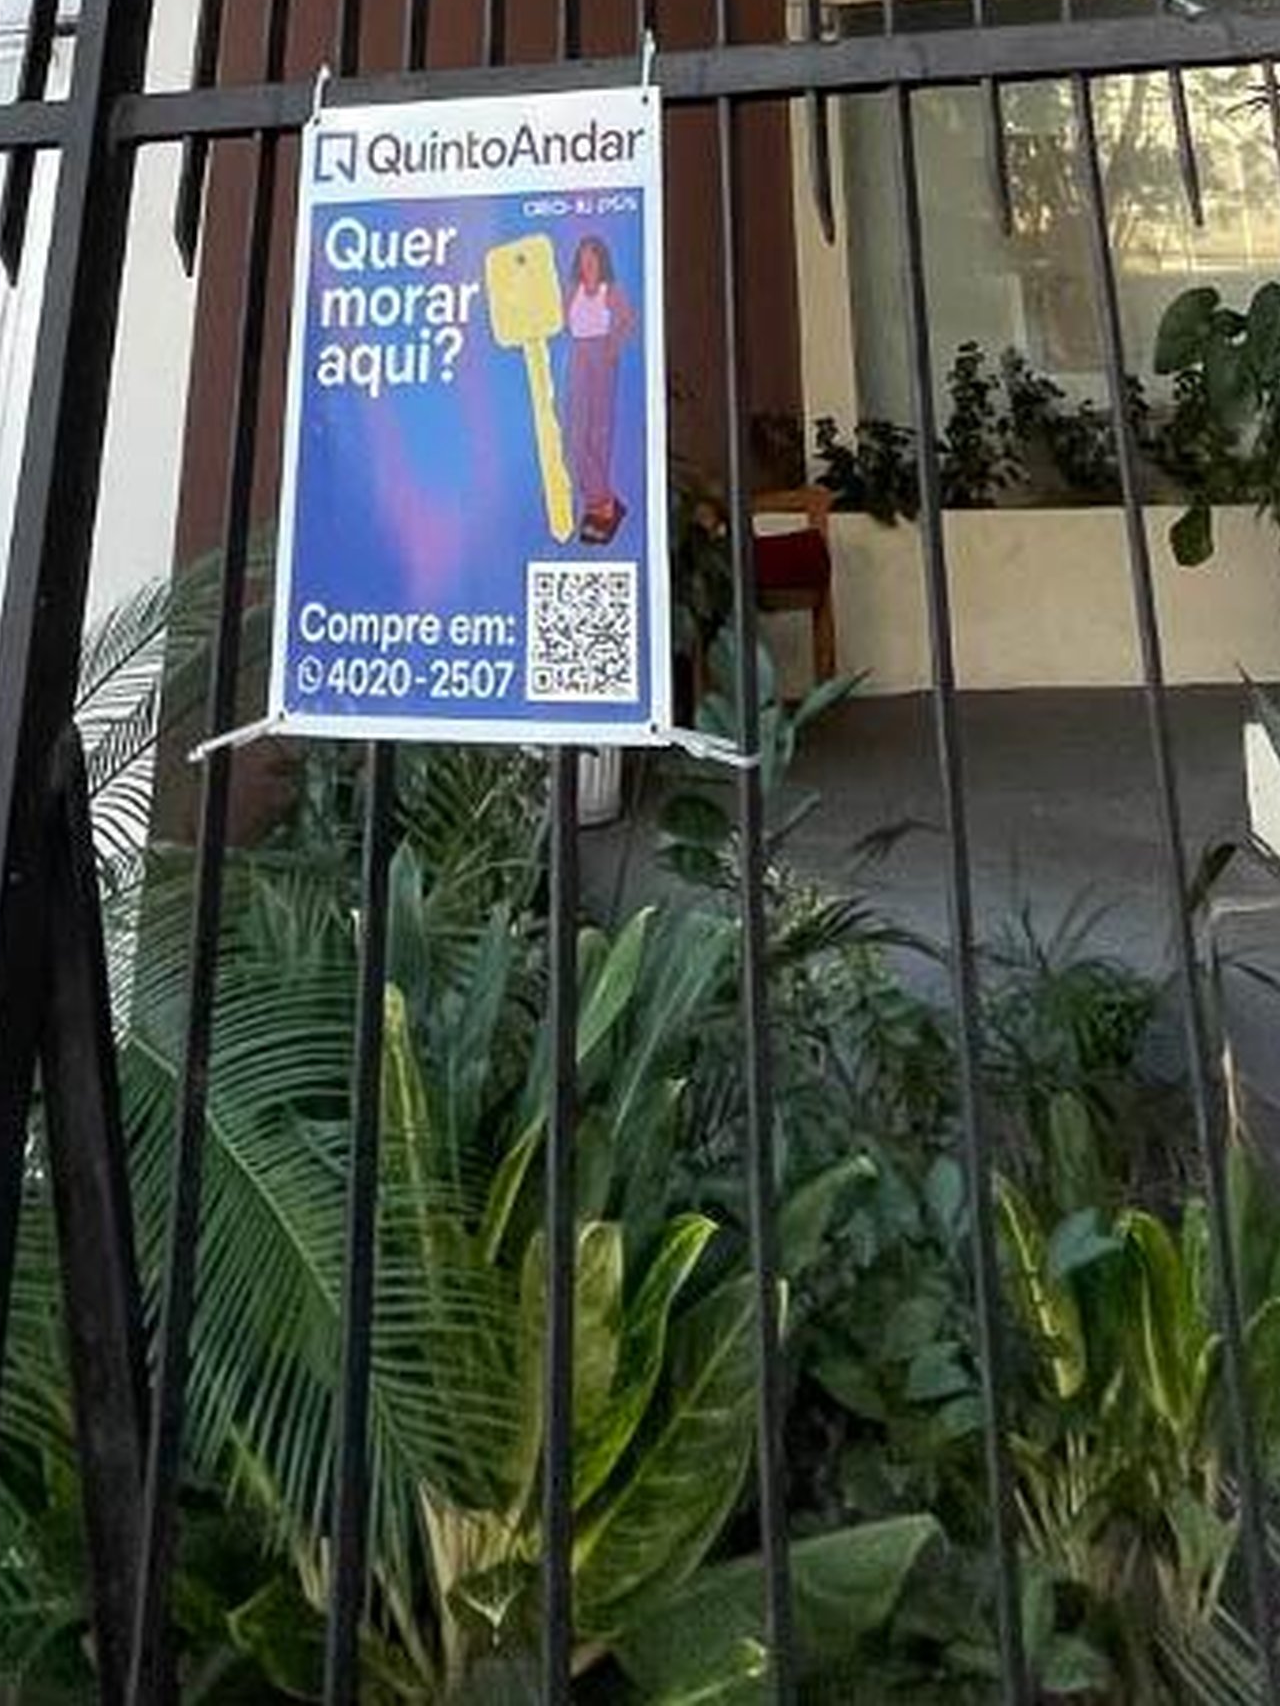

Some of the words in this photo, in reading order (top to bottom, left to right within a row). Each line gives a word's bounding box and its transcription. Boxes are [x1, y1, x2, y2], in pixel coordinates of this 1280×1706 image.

[367, 119, 646, 177] QuintoAndar
[325, 217, 458, 271] Quer
[321, 281, 480, 329] morar
[317, 330, 465, 399] aqui?
[299, 602, 442, 653] Compre
[449, 612, 516, 646] em:
[327, 657, 515, 699] 4020-2507
